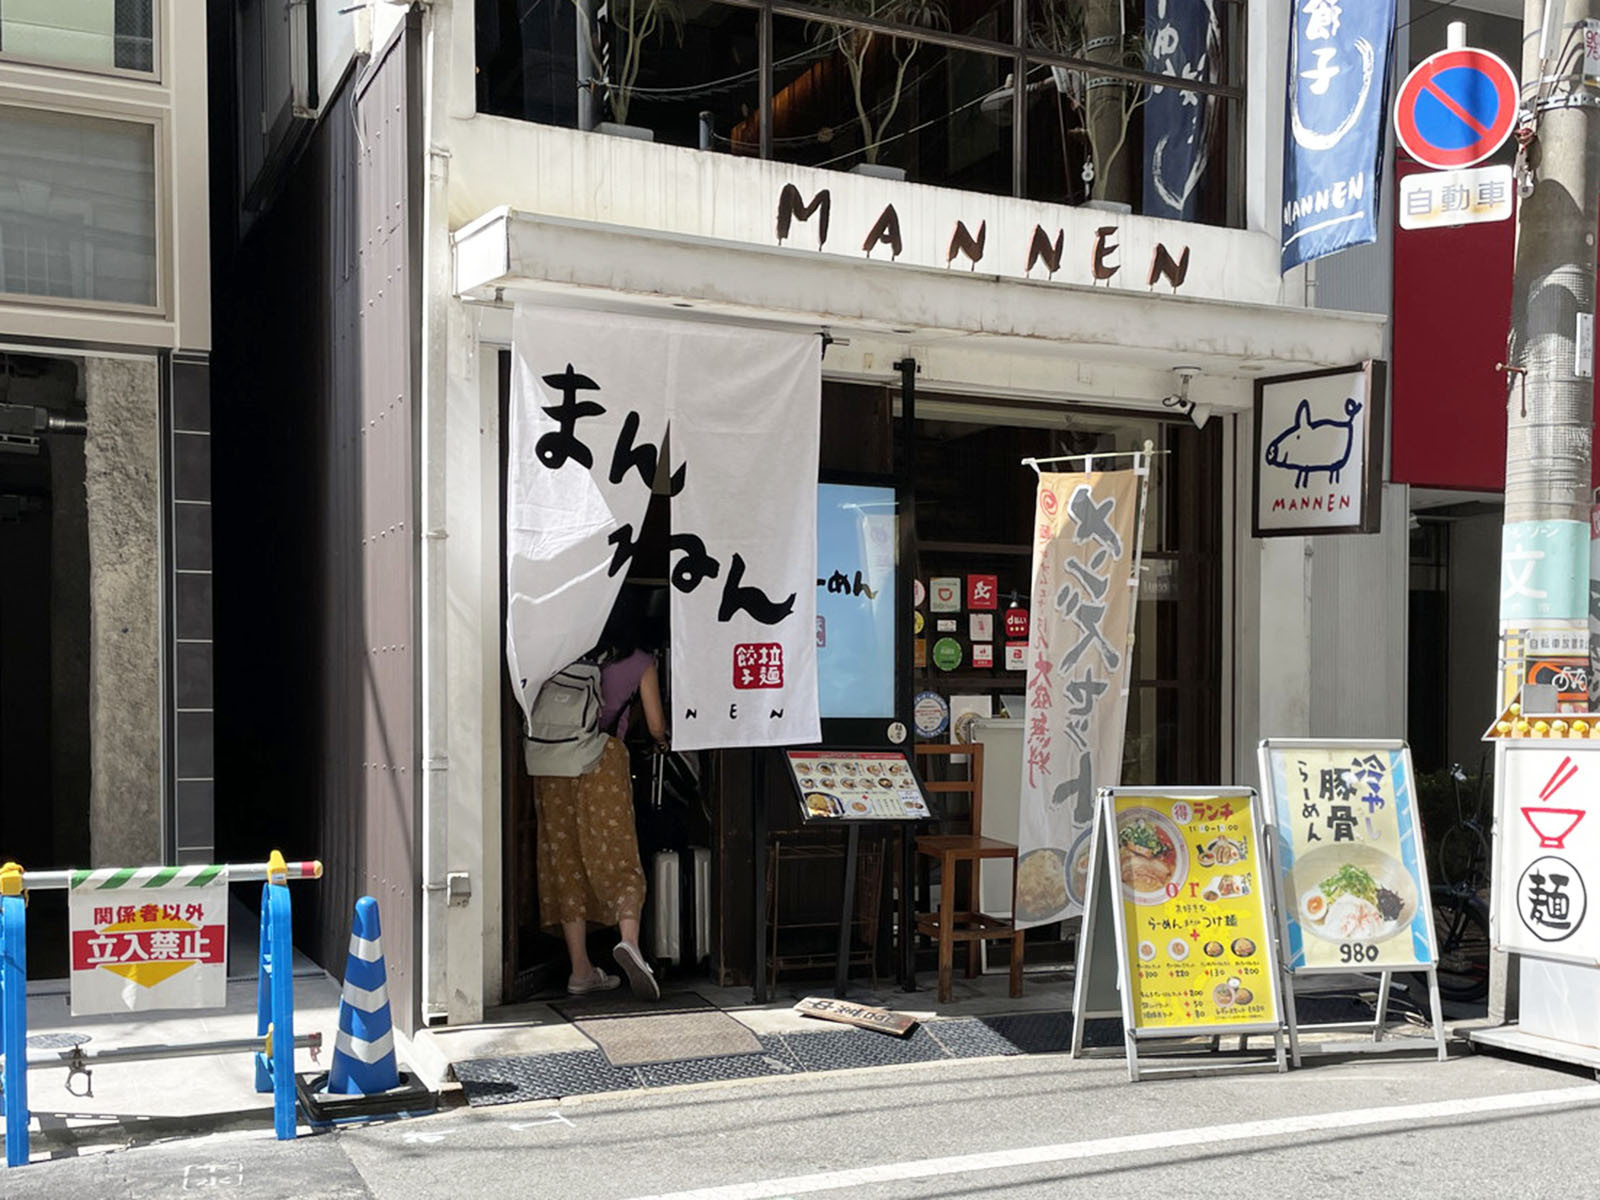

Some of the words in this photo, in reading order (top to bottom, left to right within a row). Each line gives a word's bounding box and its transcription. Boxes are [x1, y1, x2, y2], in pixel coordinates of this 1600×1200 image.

[1406, 180, 1505, 216] 自動車
[776, 183, 1189, 290] MANNEN
[1272, 494, 1350, 513] MANNEN
[1193, 802, 1234, 821] ランチ
[1297, 760, 1322, 843] らーめん
[1319, 768, 1358, 842] 豚骨
[1352, 754, 1386, 841] 冷やし
[93, 903, 204, 925] 関係者以外
[1528, 868, 1571, 931] 麺
[87, 931, 211, 963] 立入禁止
[1339, 943, 1379, 963] 980
